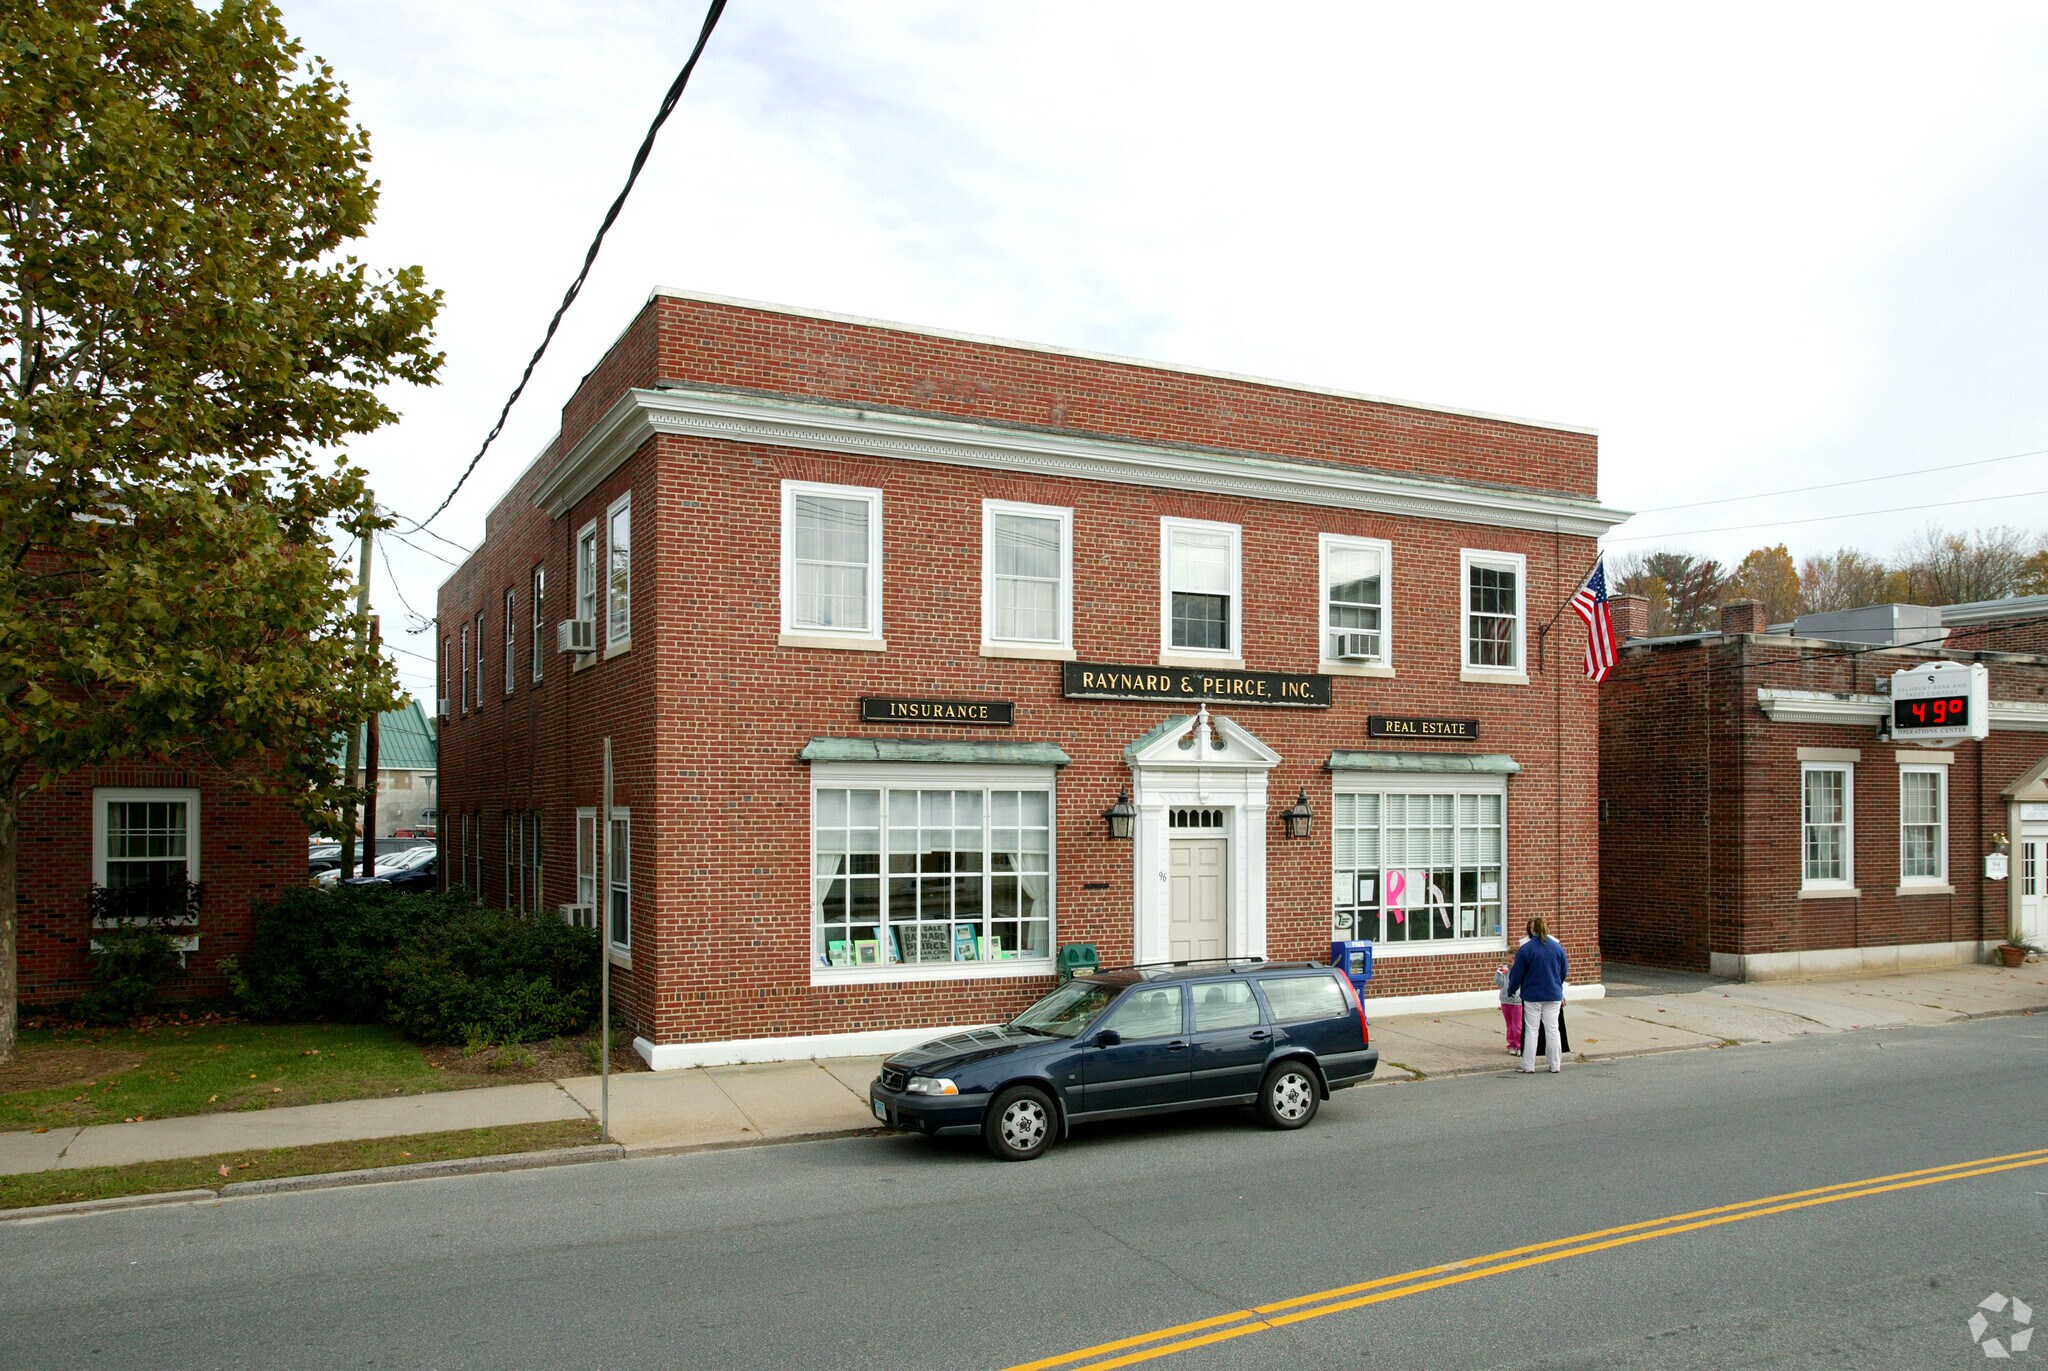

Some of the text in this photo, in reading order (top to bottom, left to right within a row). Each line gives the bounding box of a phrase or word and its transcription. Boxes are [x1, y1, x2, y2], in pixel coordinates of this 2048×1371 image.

[1082, 671, 1315, 698] RAYNARD & PEIRCE, INC.
[890, 703, 988, 719] INSURANCE
[1385, 720, 1466, 734] REAL ESTATE
[1158, 871, 1167, 882] 96
[904, 933, 946, 942] RANARD
